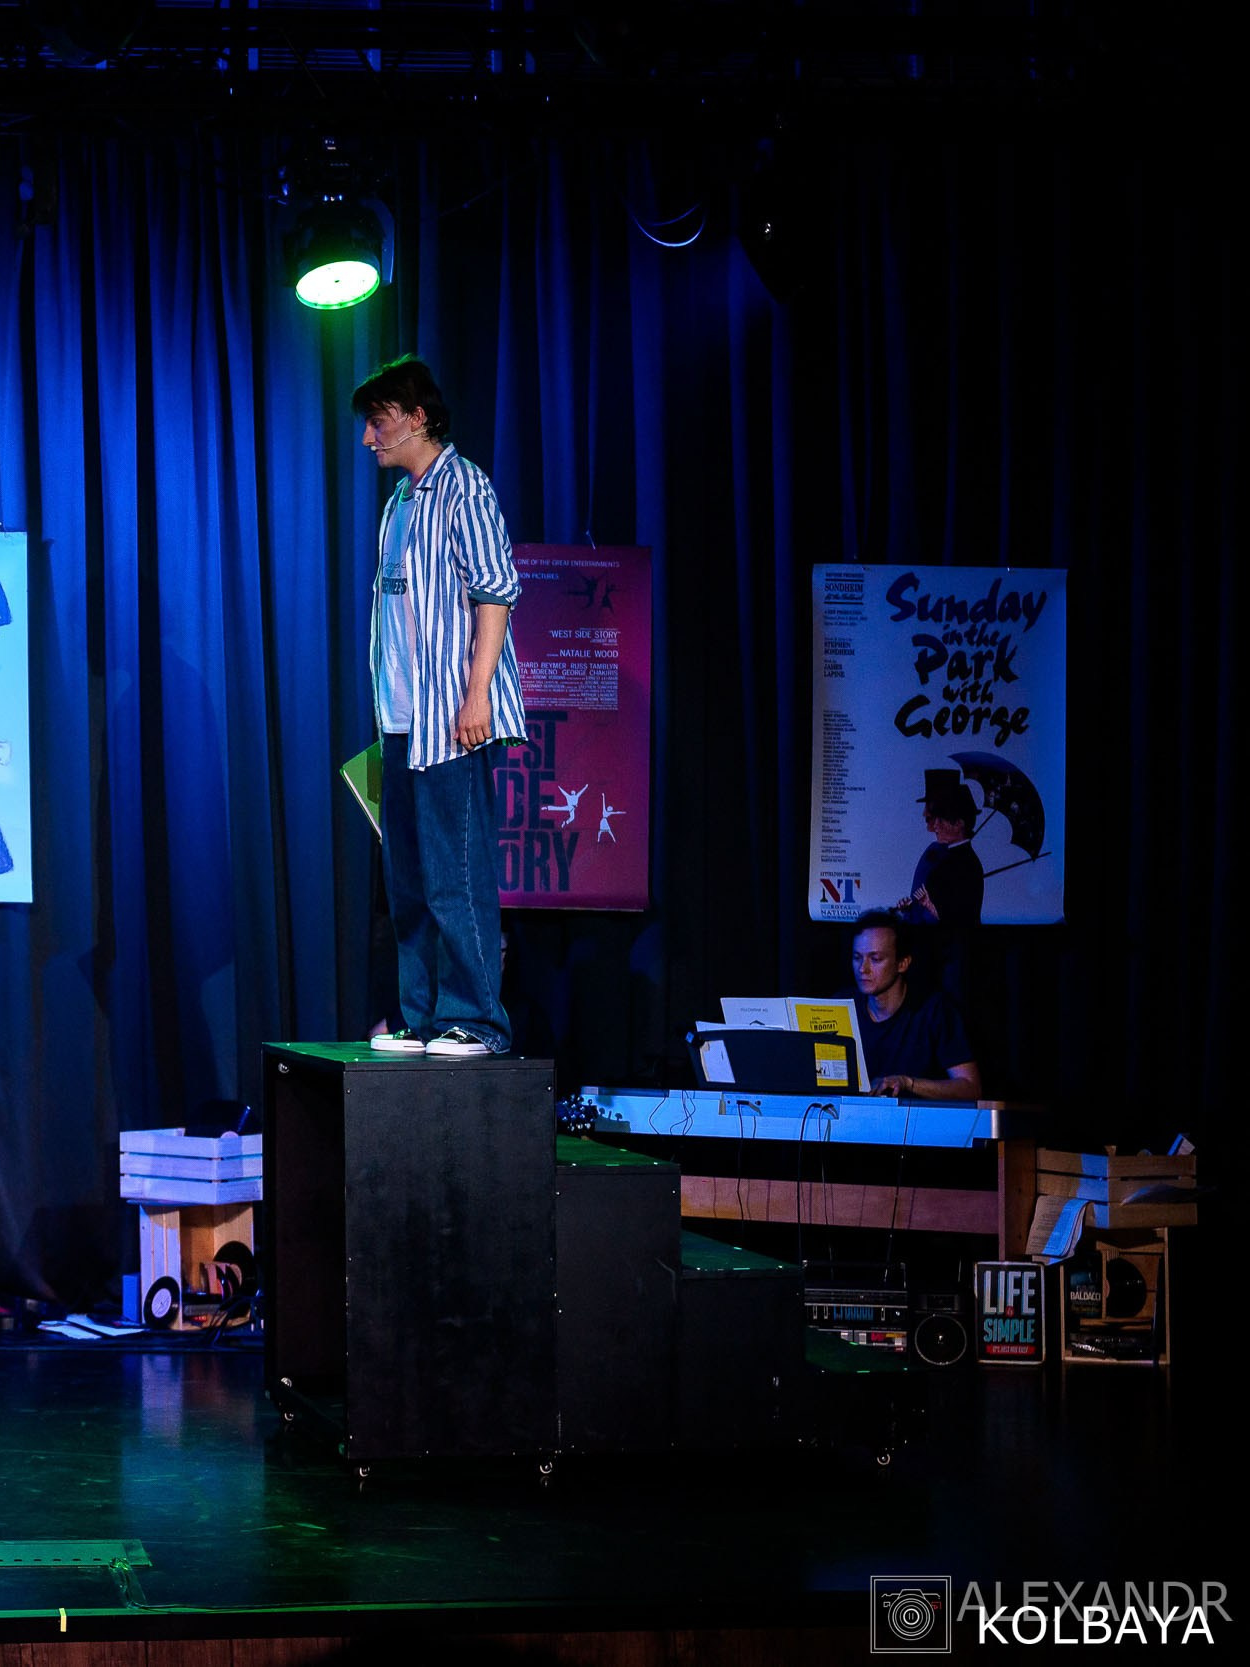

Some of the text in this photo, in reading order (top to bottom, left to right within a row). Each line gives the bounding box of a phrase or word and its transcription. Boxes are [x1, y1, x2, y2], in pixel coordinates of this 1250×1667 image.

[825, 583, 863, 592] SONDHEIM
[886, 571, 1047, 633] Sunday
[575, 630, 591, 639] SIDE
[942, 623, 1001, 647] in the
[517, 661, 538, 669] CHARD
[559, 649, 619, 658] NATALIE WOOD
[912, 634, 1019, 685] Park
[942, 680, 994, 704] with
[894, 694, 1030, 747] George
[496, 771, 556, 829] DE
[497, 831, 580, 891] ORY
[820, 878, 861, 903] NT
[983, 1270, 1037, 1315] LIFE
[983, 1318, 1036, 1343] SIMPLE
